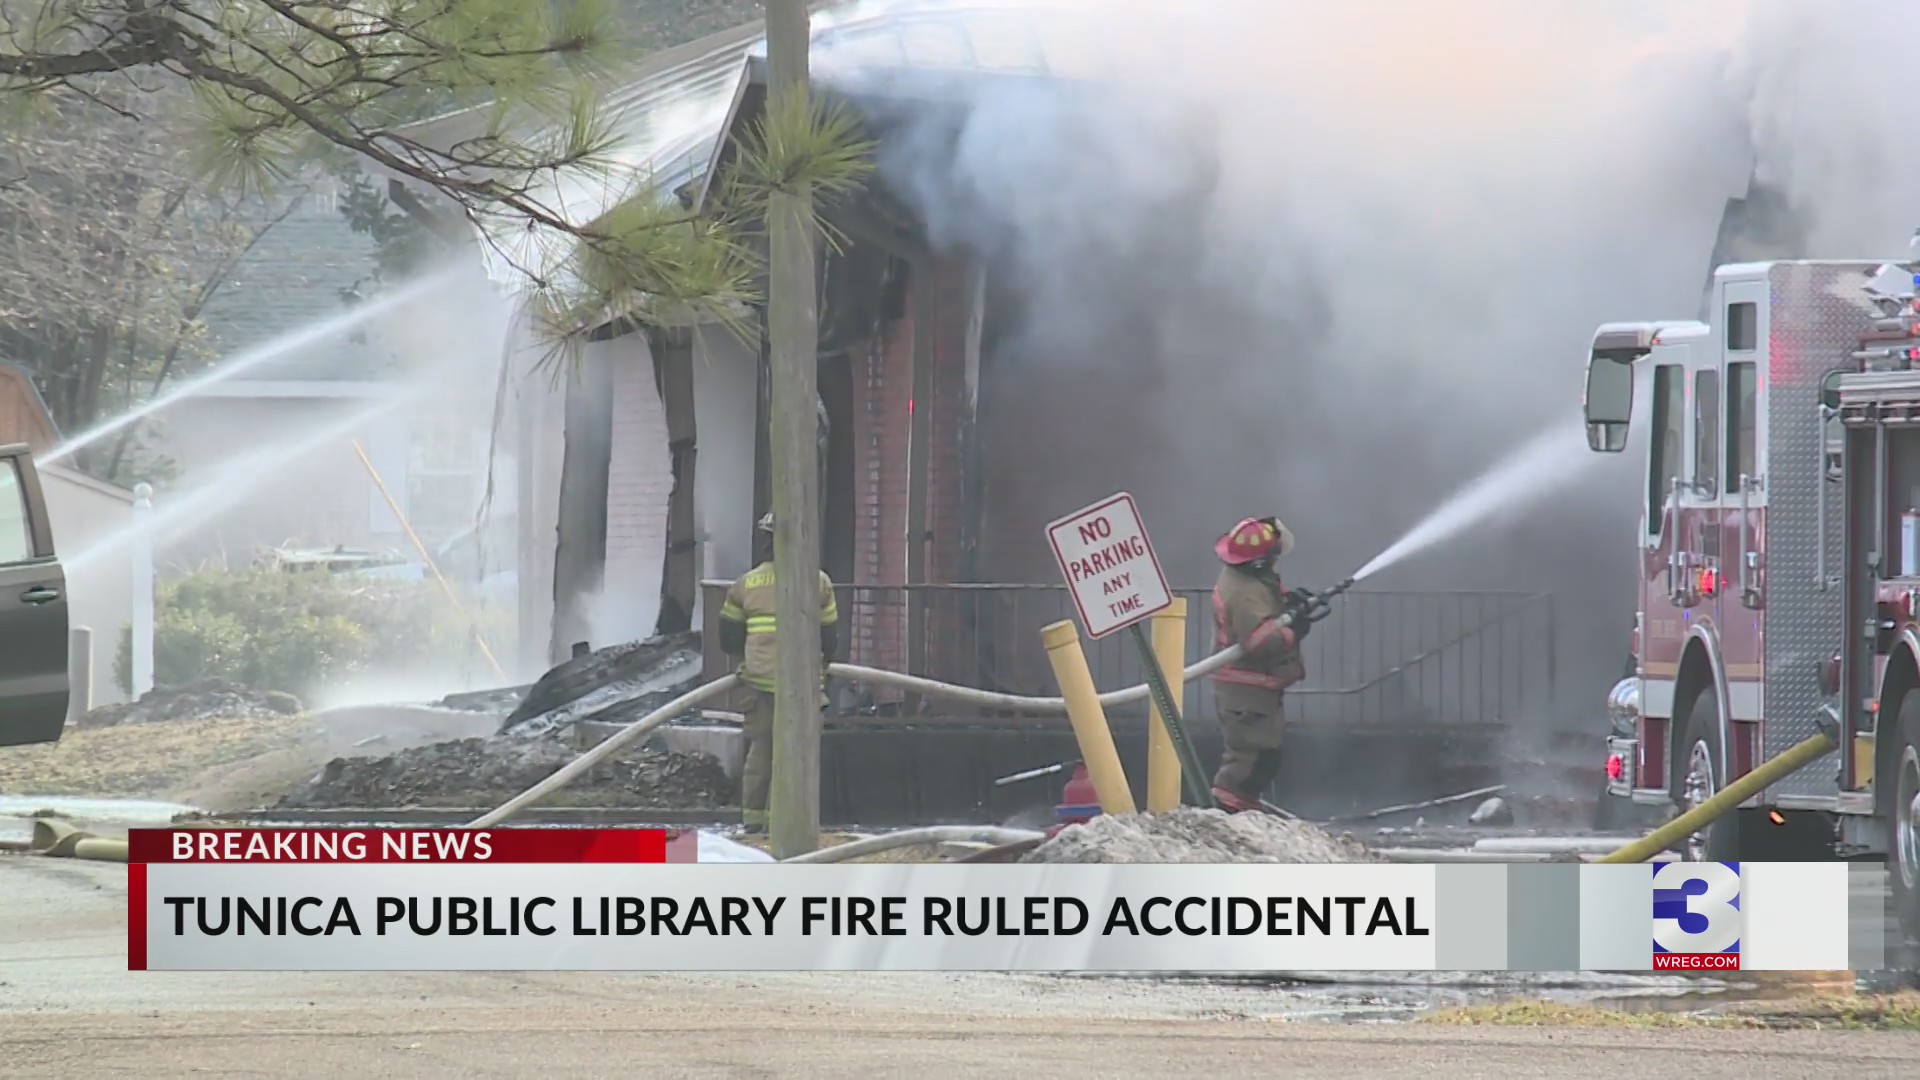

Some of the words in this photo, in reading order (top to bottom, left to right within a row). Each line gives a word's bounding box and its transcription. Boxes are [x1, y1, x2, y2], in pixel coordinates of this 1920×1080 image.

[1078, 517, 1111, 545] NO
[1070, 536, 1144, 583] PARKING
[1103, 572, 1132, 595] ANY
[1108, 593, 1144, 618] TIME
